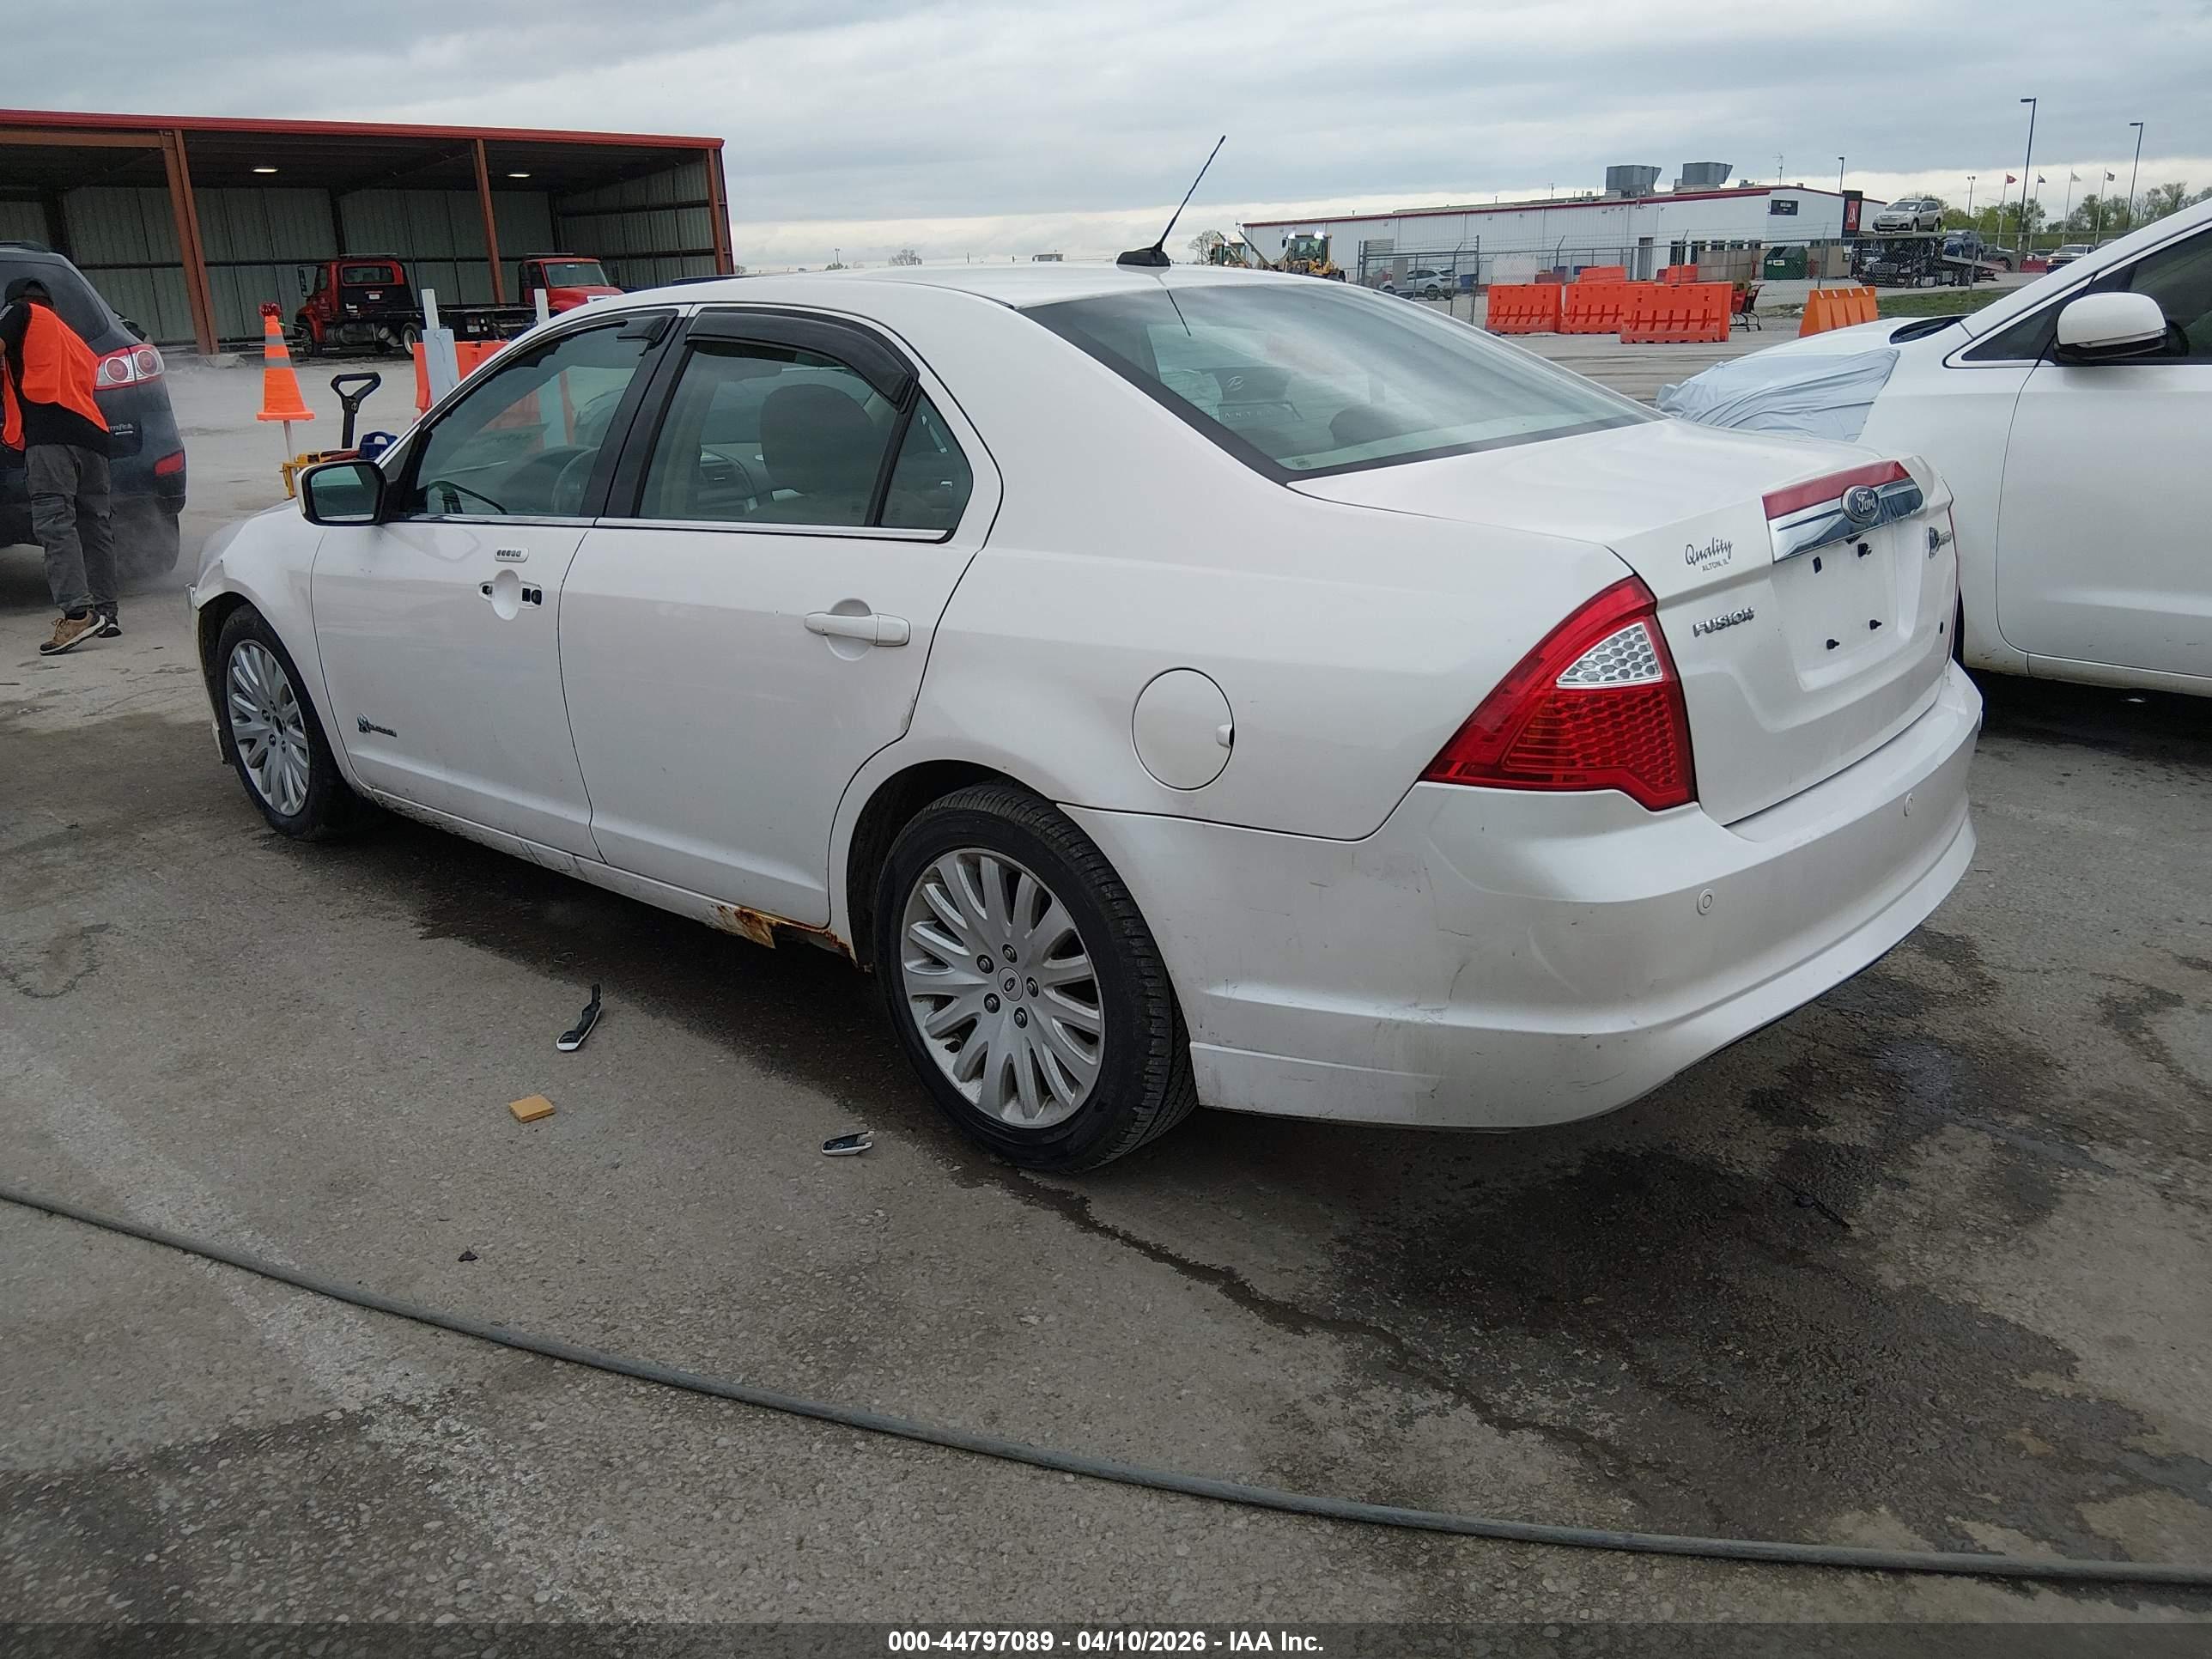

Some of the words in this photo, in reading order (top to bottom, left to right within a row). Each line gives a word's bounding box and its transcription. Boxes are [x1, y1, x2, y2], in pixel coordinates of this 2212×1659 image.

[1856, 489, 1877, 513] Ford
[1685, 537, 1733, 566] Quality
[1692, 606, 1754, 637] FUSION
